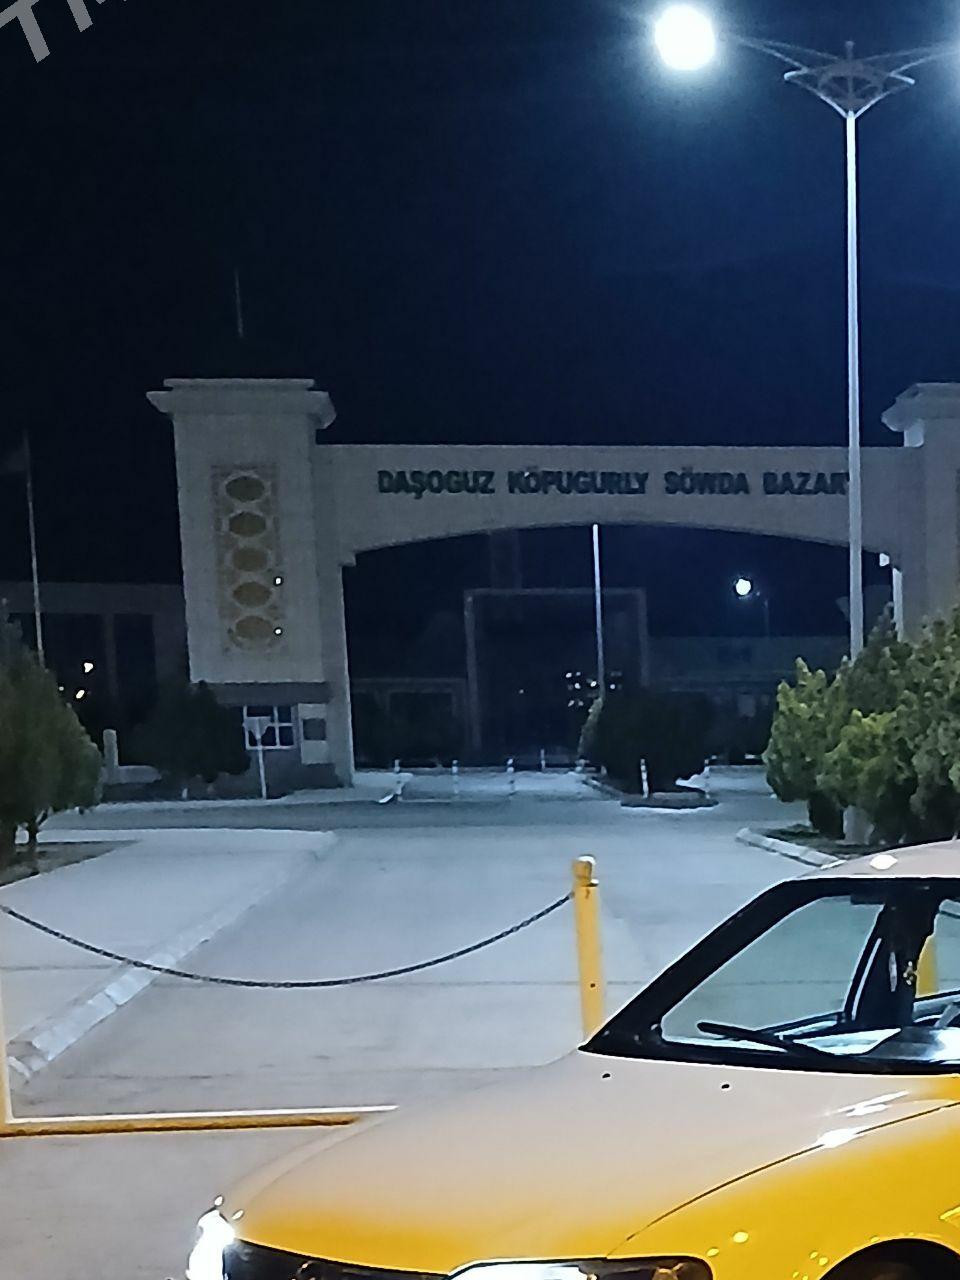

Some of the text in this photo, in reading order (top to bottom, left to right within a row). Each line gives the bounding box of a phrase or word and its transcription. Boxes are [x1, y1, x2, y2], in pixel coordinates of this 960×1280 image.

[377, 470, 496, 499] DAŞOGUZ
[664, 466, 750, 495] SÖWDA
[762, 470, 850, 495] BAZAR
